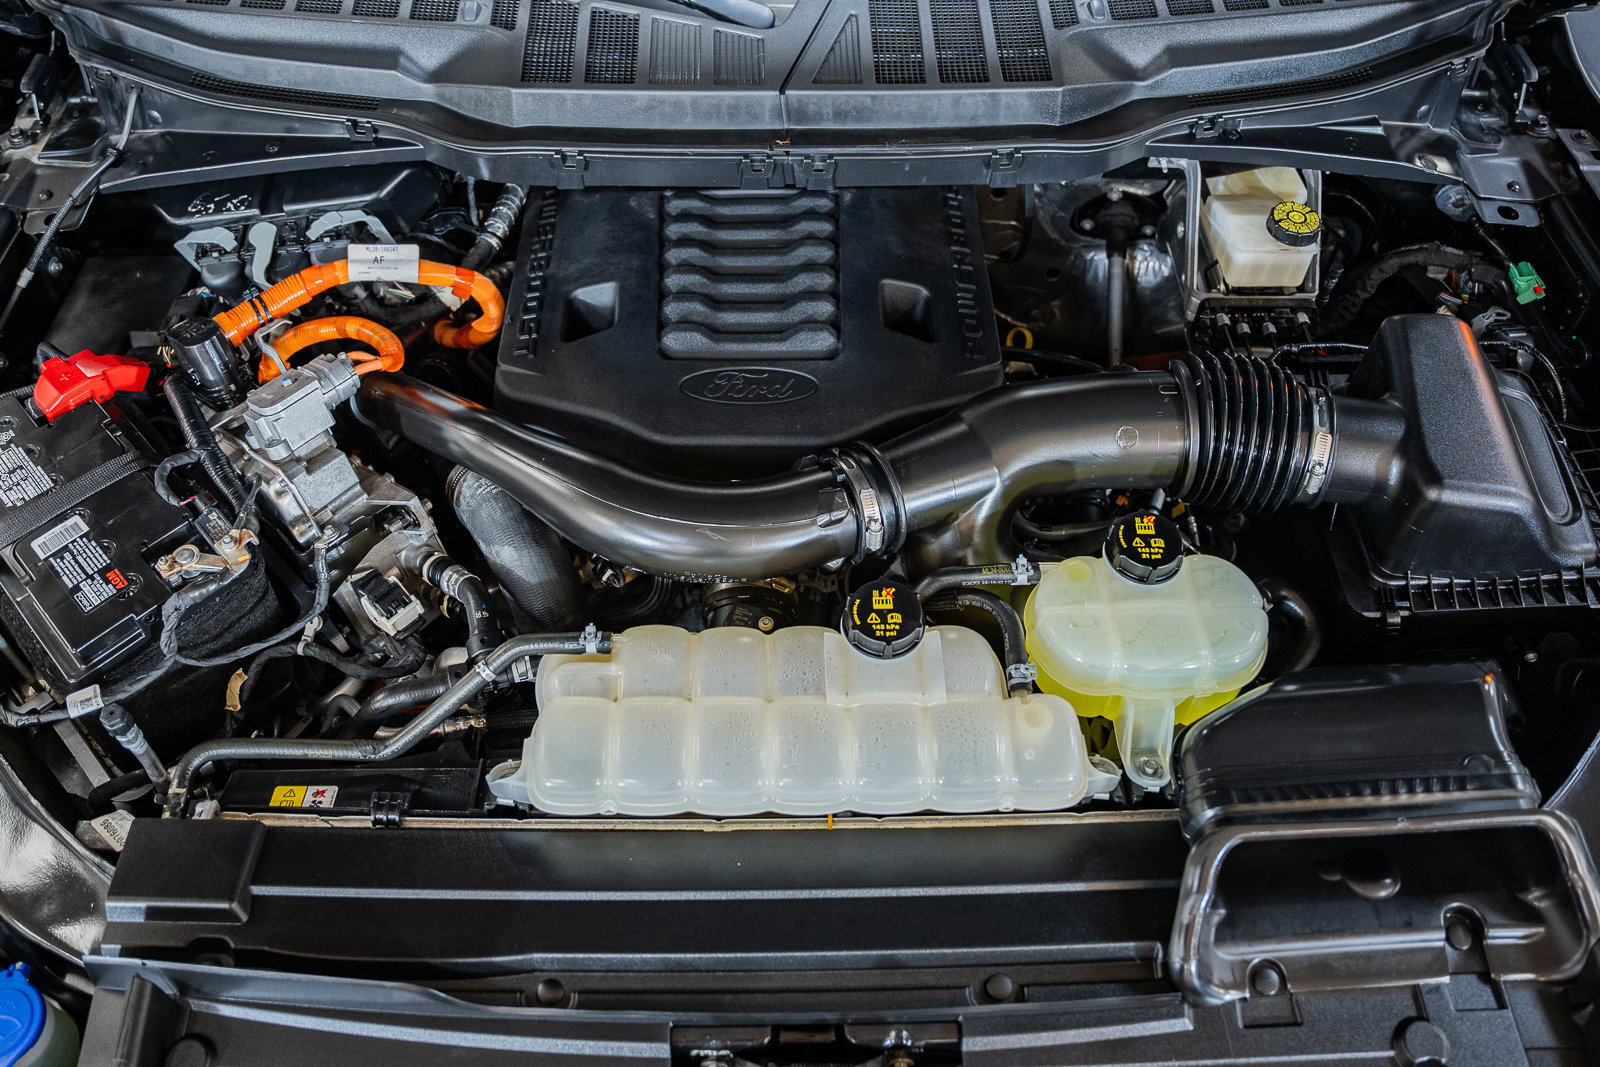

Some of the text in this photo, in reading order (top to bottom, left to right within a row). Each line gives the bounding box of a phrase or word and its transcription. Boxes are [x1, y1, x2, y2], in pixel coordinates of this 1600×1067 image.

[372, 255, 385, 264] AF
[703, 371, 794, 398] Ford
[105, 570, 126, 590] AGM
